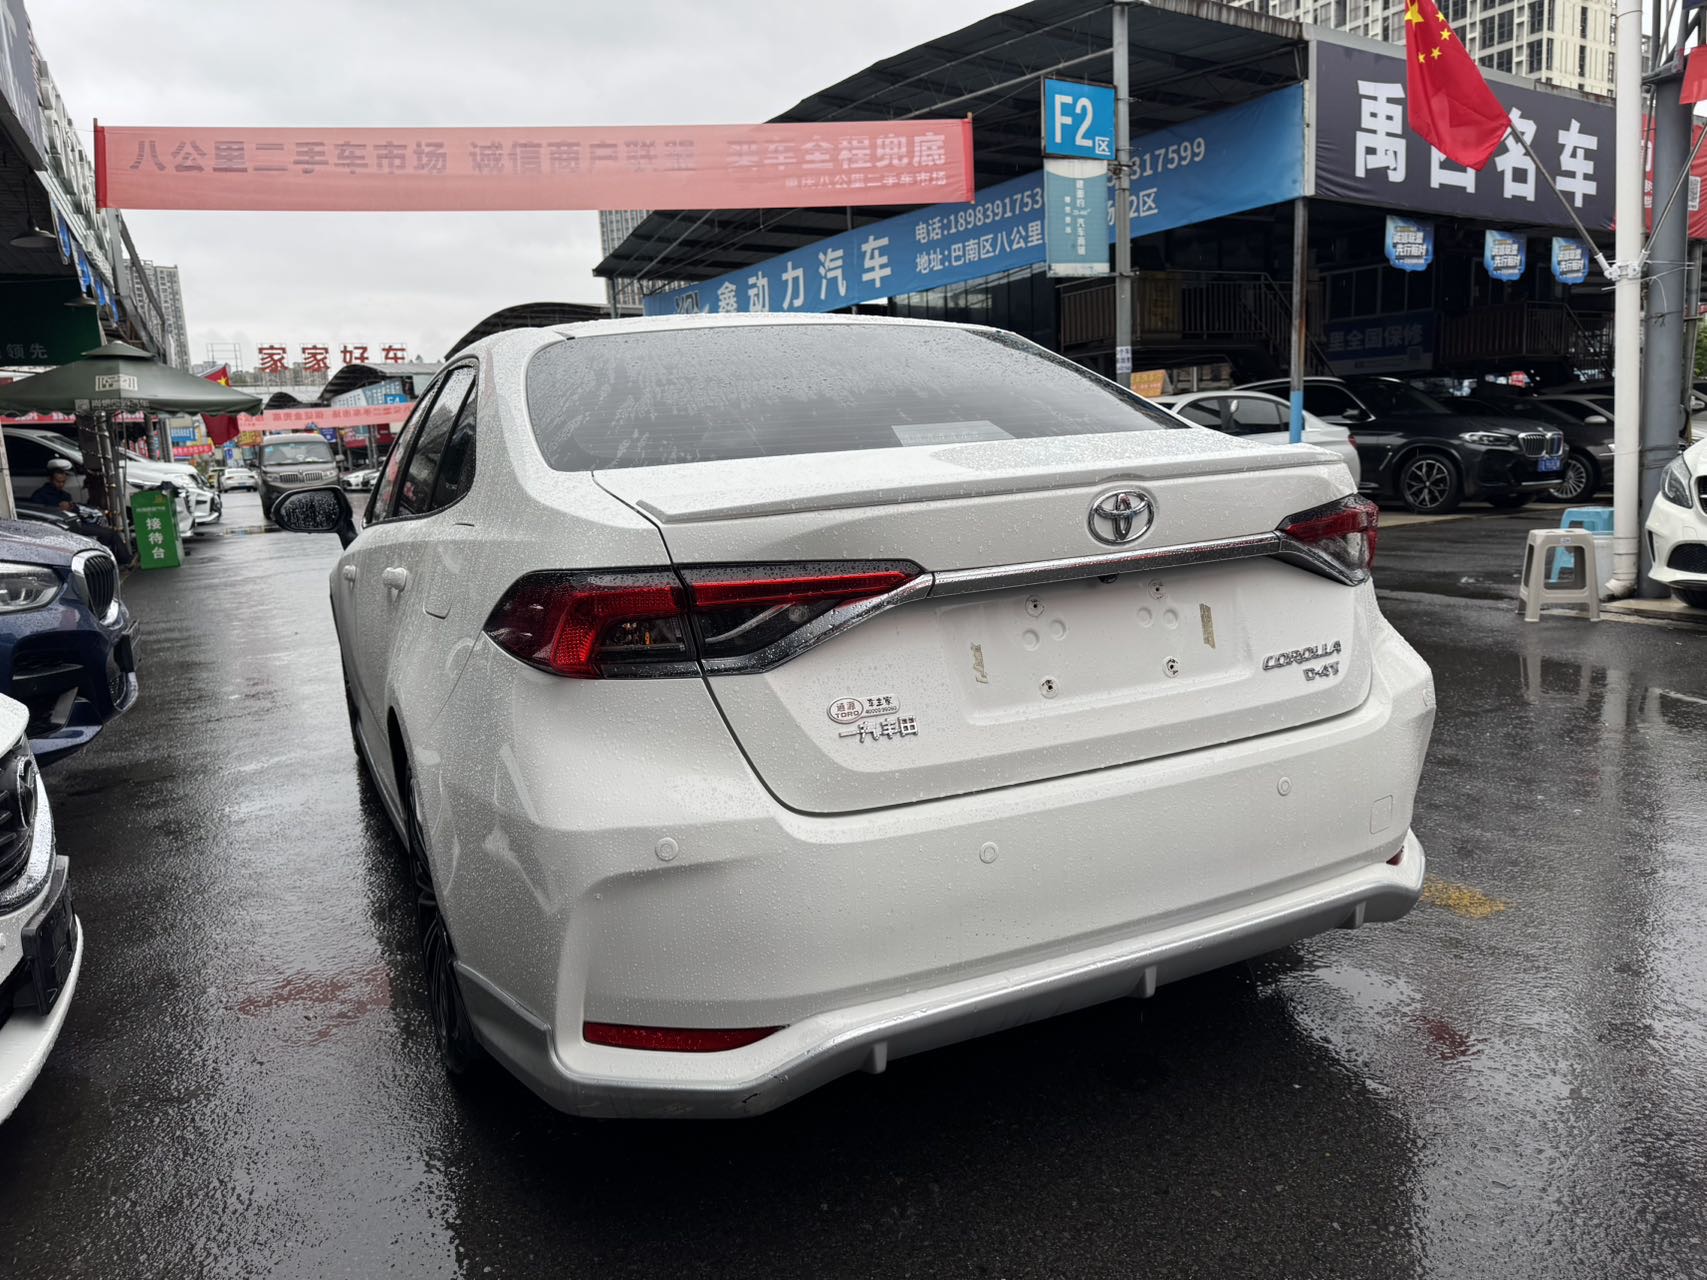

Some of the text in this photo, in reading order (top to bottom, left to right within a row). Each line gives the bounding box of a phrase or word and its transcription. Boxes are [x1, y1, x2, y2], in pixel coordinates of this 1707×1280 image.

[129, 140, 448, 175] 八公里二手车市场
[469, 138, 697, 175] 诚信商户联盟
[257, 343, 407, 374] 家家好车
[145, 517, 166, 560] 接待台
[1262, 640, 1342, 671] COROLLA
[838, 715, 918, 743] 一汽丰田
